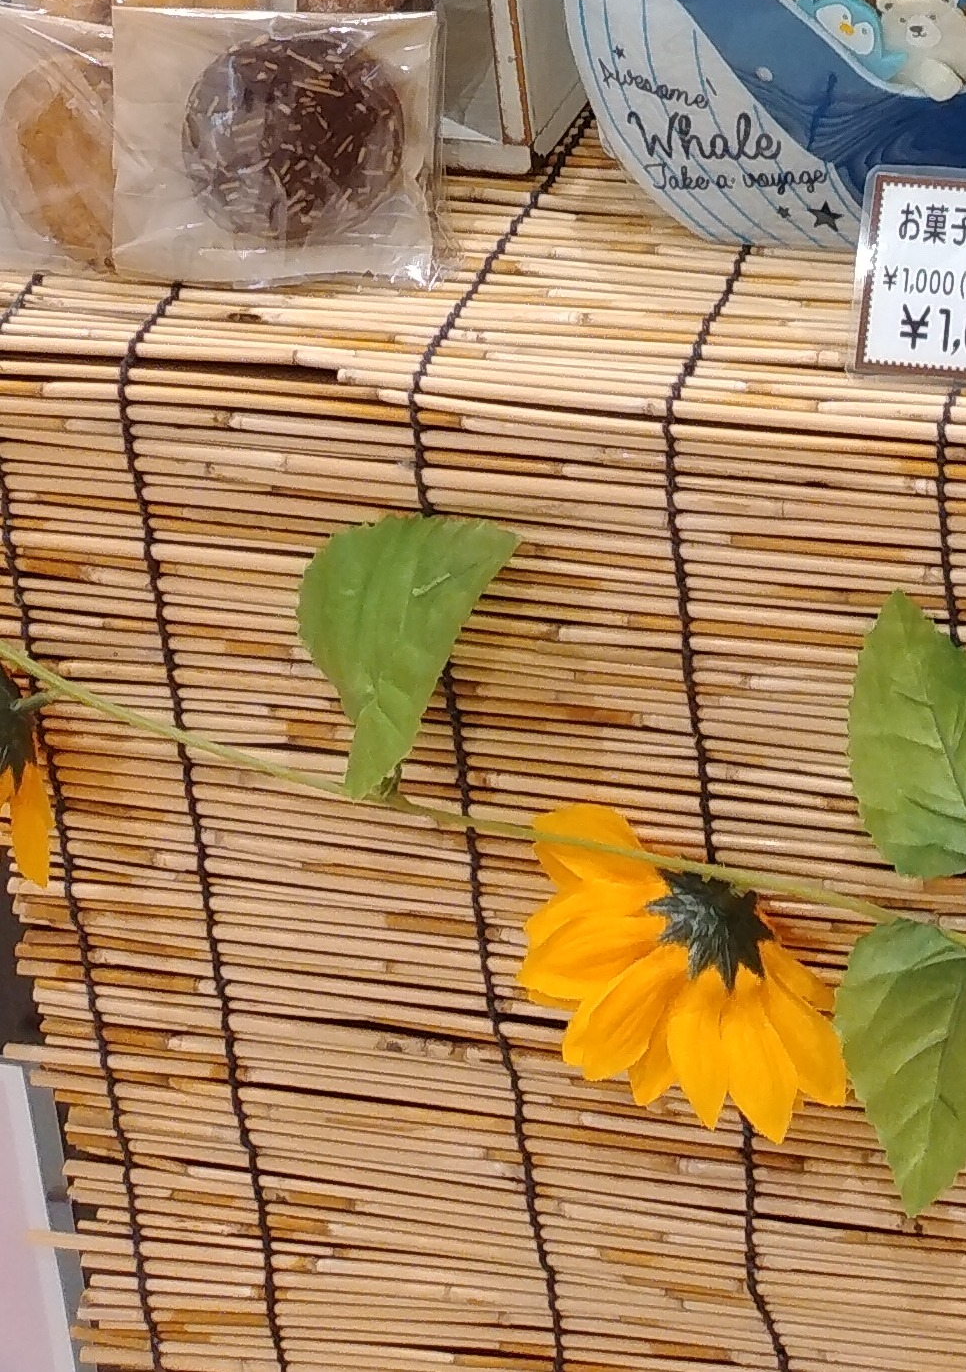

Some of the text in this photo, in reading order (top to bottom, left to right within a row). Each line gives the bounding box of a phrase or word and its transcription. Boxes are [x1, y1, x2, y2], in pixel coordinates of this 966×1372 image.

[597, 57, 710, 109] Awesome
[626, 110, 782, 161] Whale
[643, 161, 829, 196] Take a voyage
